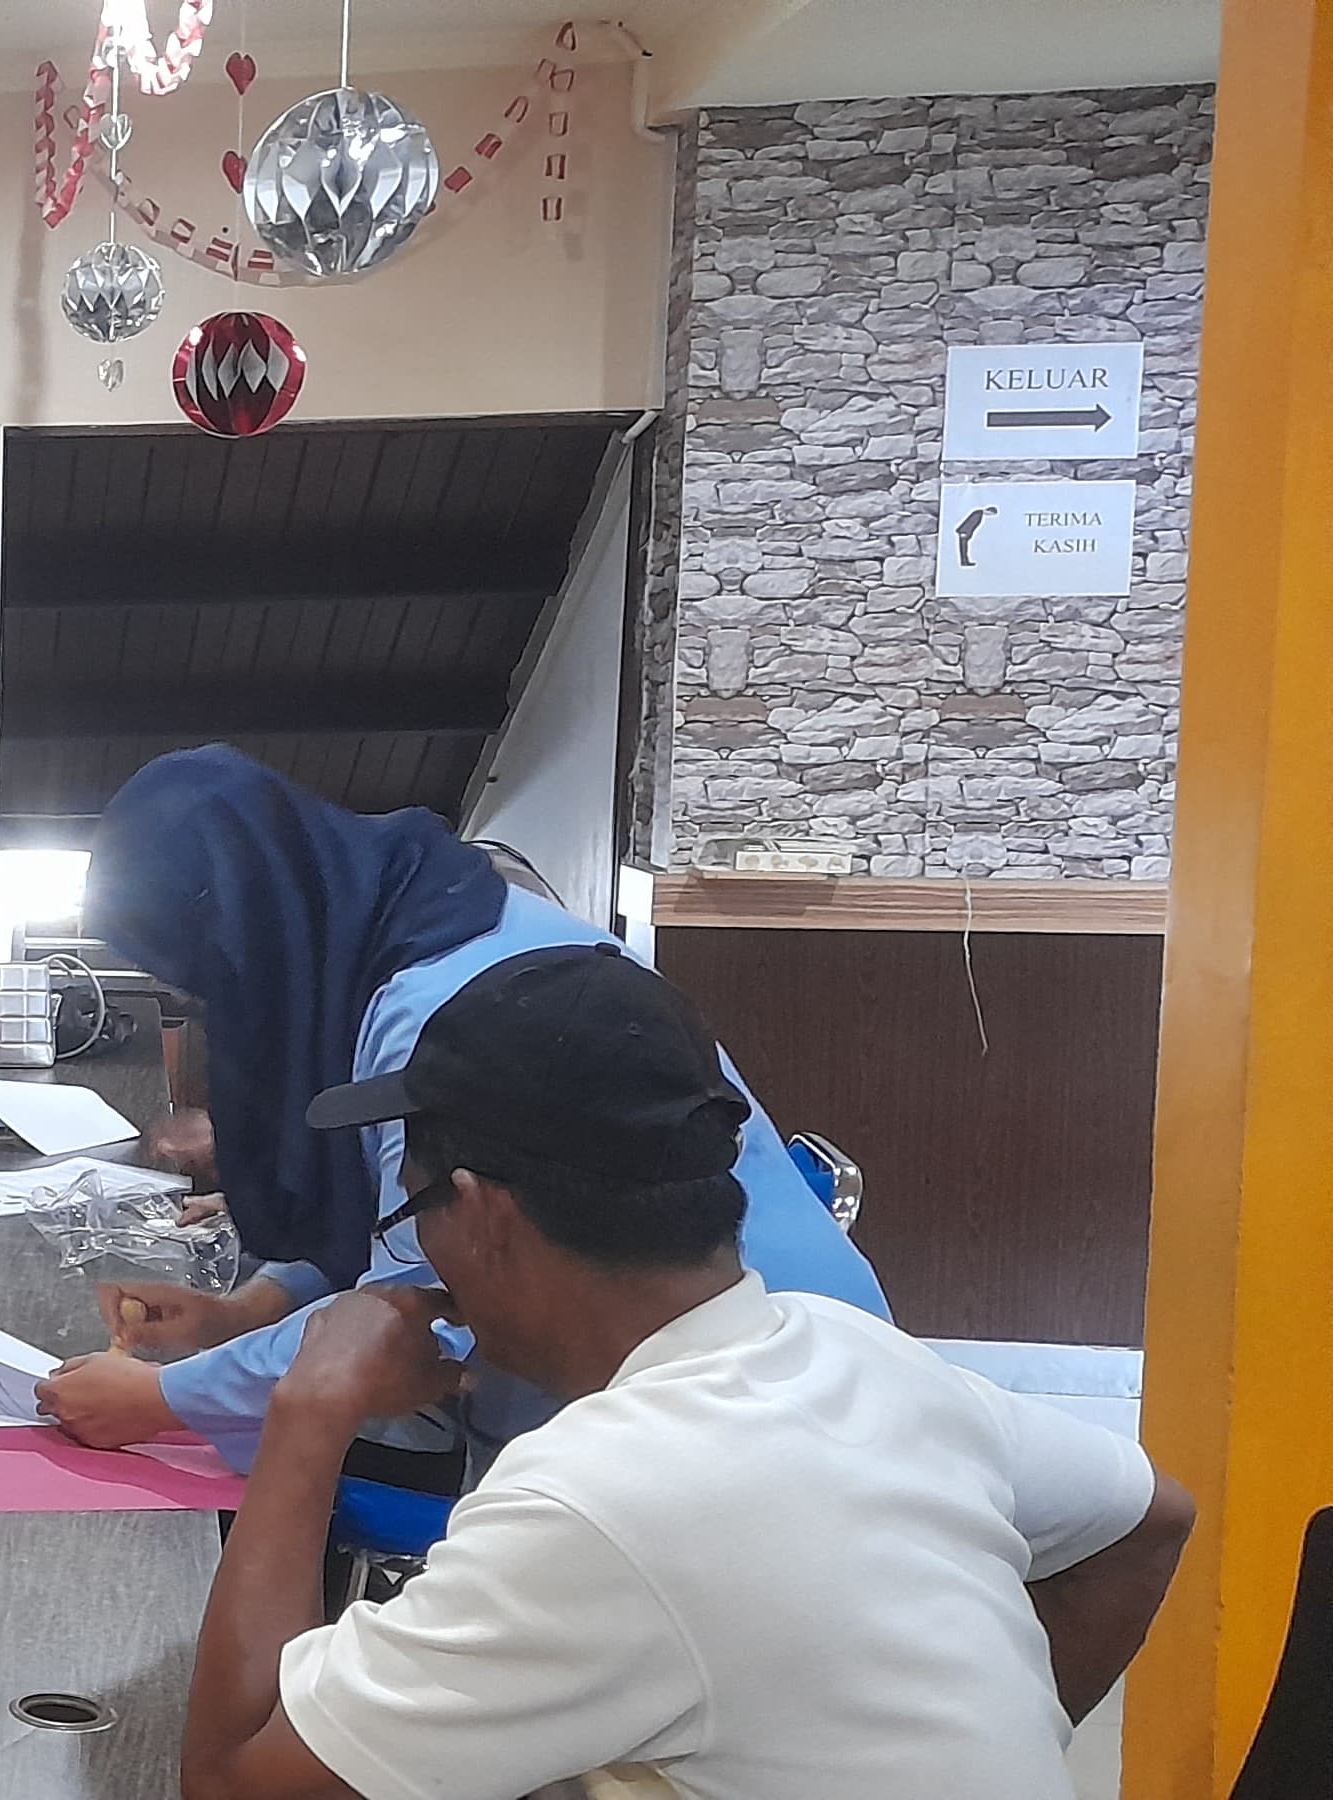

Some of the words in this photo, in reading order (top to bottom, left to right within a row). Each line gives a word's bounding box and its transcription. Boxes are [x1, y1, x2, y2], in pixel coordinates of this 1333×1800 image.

[985, 368, 1109, 390] KELUAR
[1025, 513, 1102, 527] TERIMA
[1033, 539, 1096, 553] KASIH
